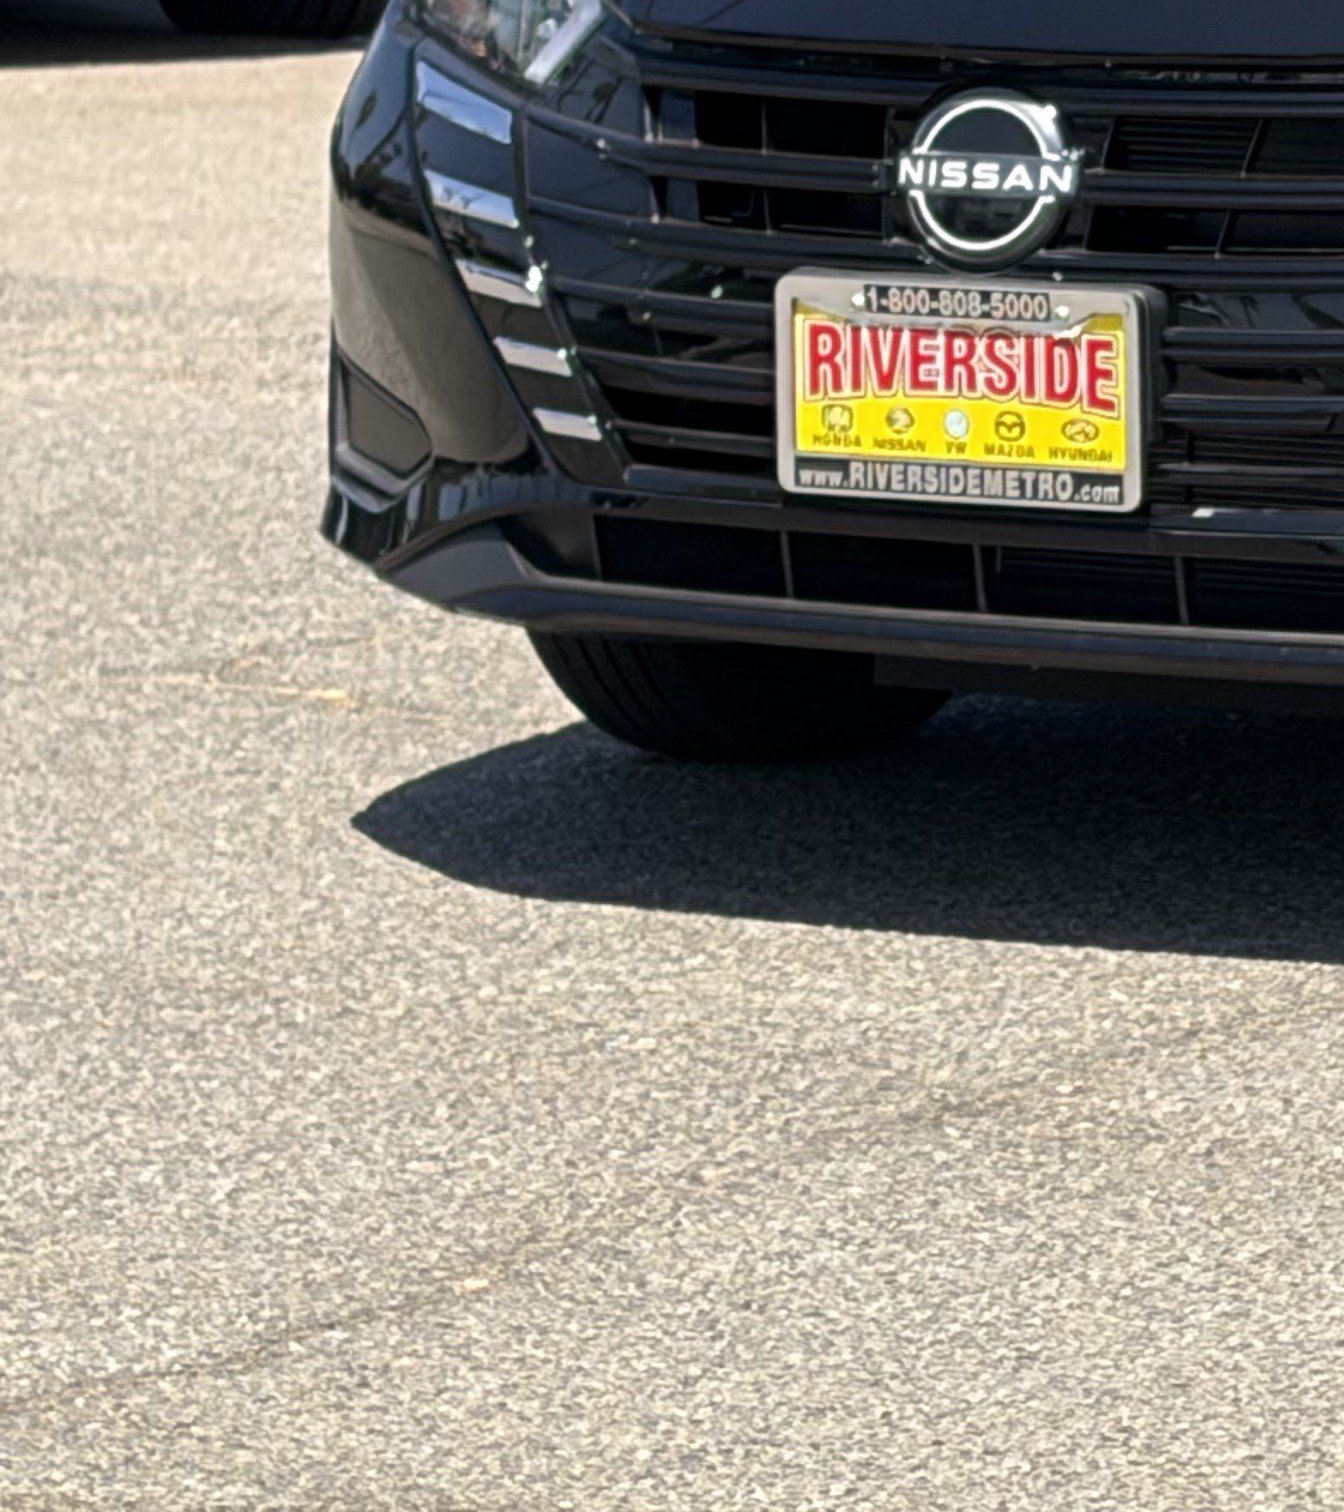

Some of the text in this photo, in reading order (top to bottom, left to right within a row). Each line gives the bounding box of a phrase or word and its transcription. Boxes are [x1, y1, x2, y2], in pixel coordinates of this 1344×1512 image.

[899, 157, 1073, 192] NISSAN
[867, 287, 1049, 320] 1-800-808-5000
[804, 320, 1119, 416] RIVERSIDE
[812, 433, 862, 448] HONDA
[873, 437, 927, 453] NISSAN
[983, 442, 1036, 460] MAZDA
[799, 461, 1120, 504] www.RIVERSIDEMETRO.com
